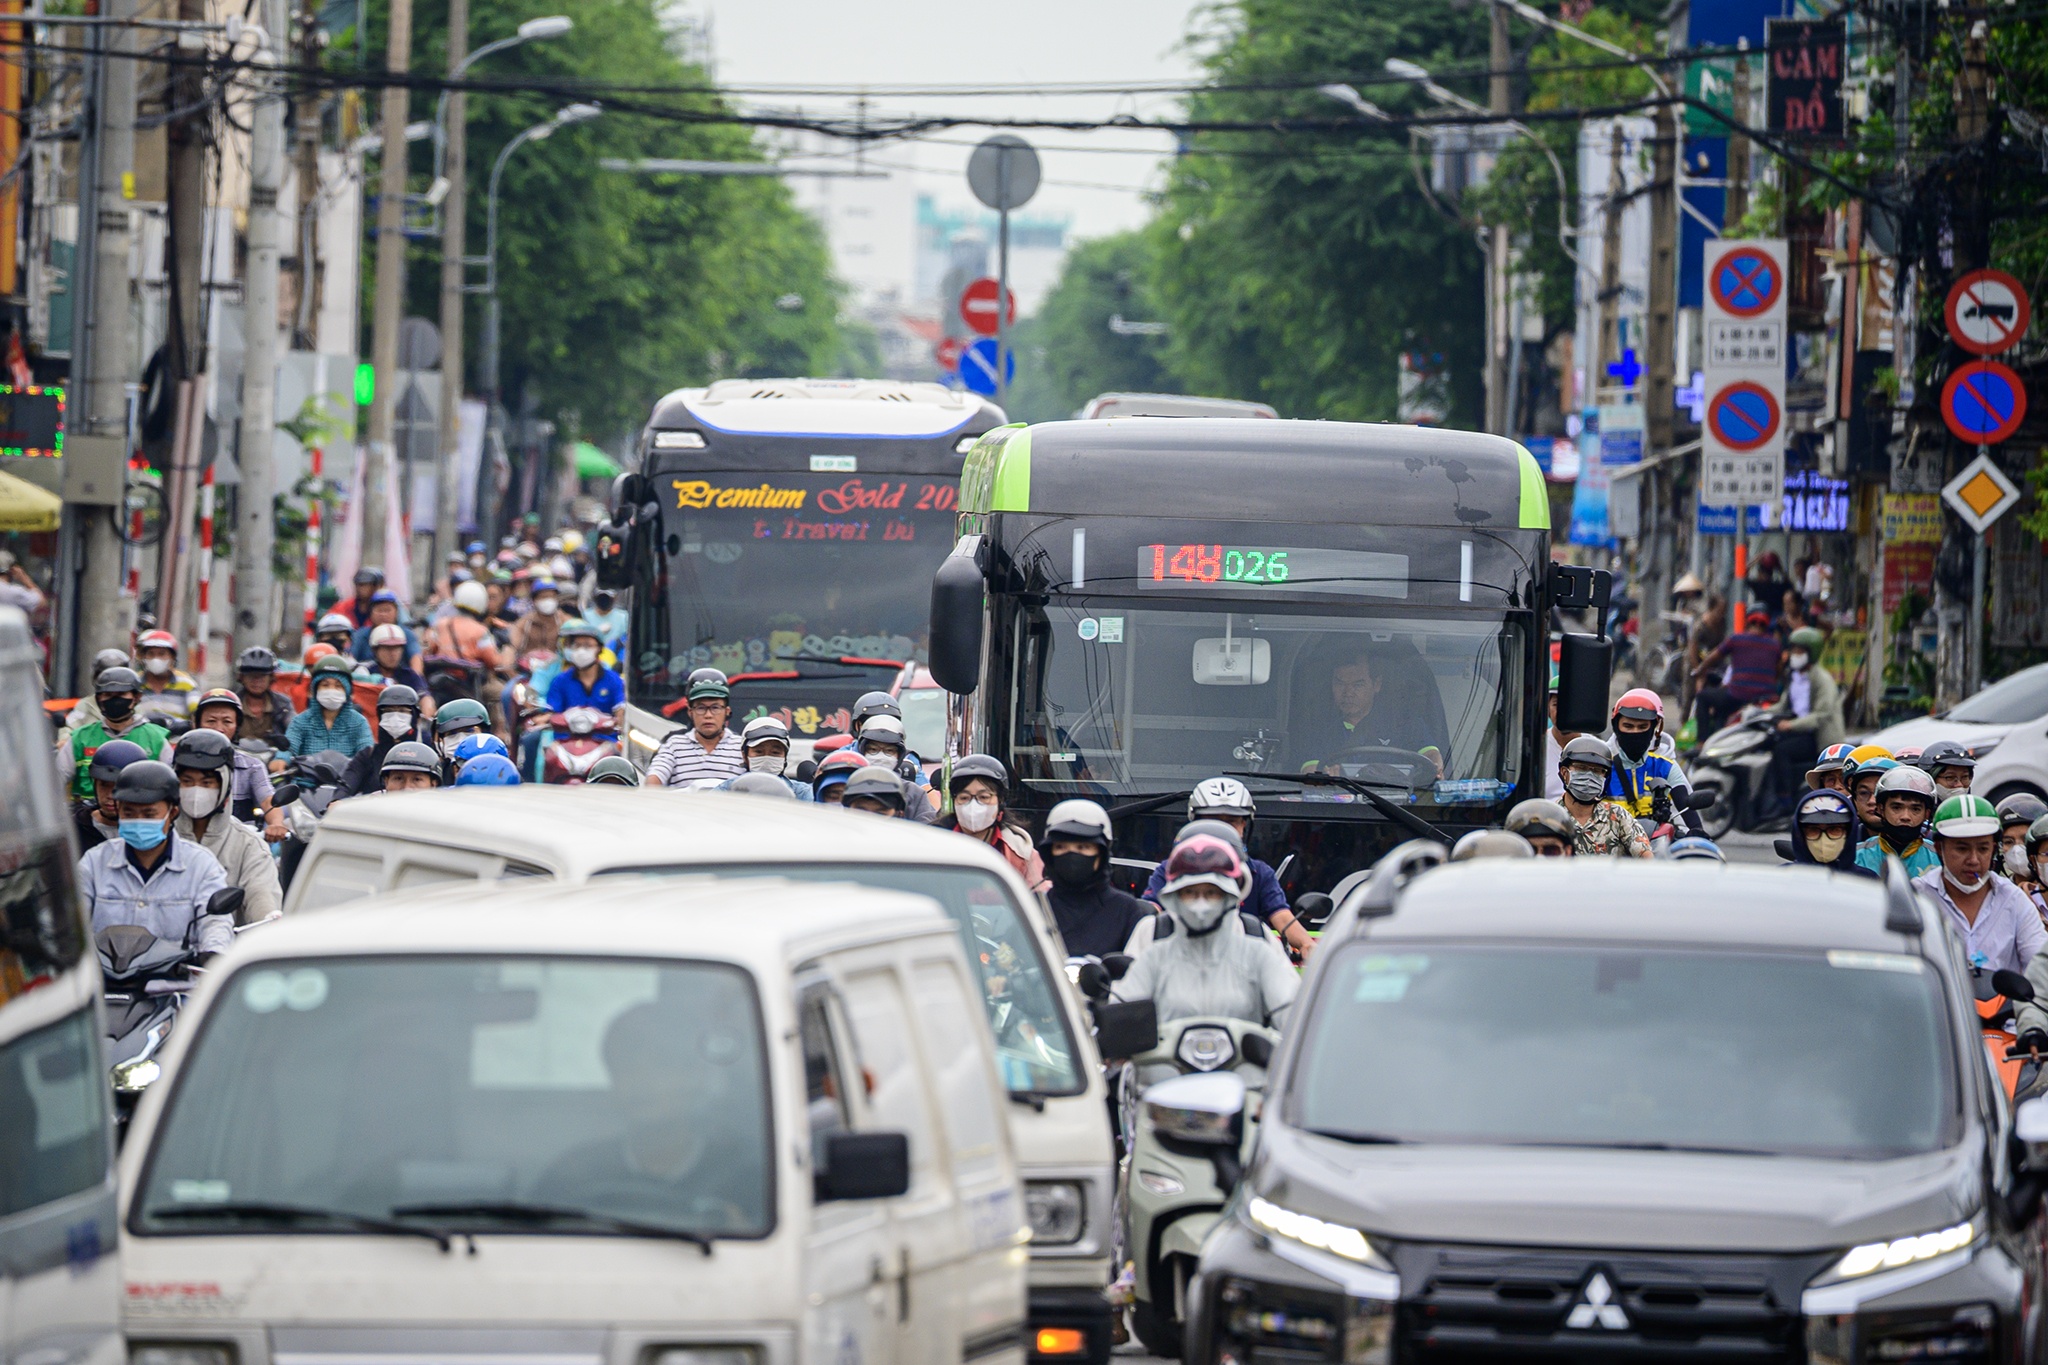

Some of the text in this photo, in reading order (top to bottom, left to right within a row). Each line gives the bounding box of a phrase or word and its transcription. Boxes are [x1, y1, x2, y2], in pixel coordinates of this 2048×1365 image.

[672, 479, 807, 509] Premium
[817, 479, 908, 514] Gold
[1149, 544, 1289, 582] 148 026
